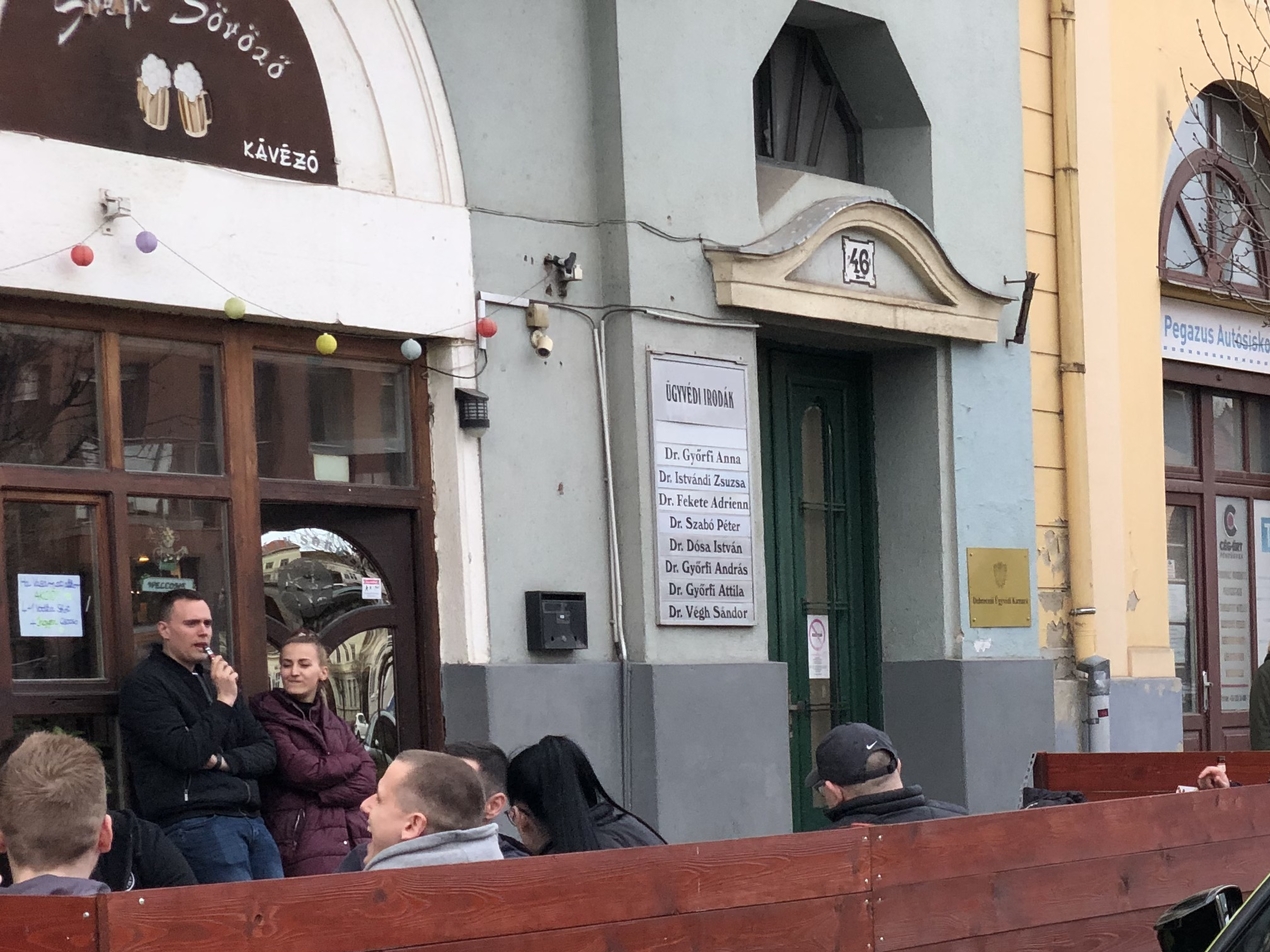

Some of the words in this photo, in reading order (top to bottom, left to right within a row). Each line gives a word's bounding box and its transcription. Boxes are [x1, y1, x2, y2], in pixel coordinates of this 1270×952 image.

[243, 137, 319, 174] KÁVÉZÓ
[849, 247, 870, 276] 46
[1164, 314, 1215, 346] Pegazus
[665, 380, 702, 405] ÜGYVÉDI
[703, 386, 735, 409] IRODÁK
[664, 446, 681, 460] Dr.
[682, 448, 714, 465] Győrfi
[716, 451, 742, 465] Anna
[658, 469, 673, 483] Dr.
[674, 471, 711, 487] Istvándi
[713, 474, 747, 489] Zsuzsa
[658, 493, 675, 506] Dr.
[676, 494, 709, 508] Fekete
[710, 497, 749, 510] Adrienn
[669, 516, 683, 529] Dr.
[685, 516, 715, 531] Szabó
[717, 518, 741, 532] Péter
[669, 538, 684, 552] Dr.
[686, 539, 711, 553] Dósa
[713, 540, 743, 554] István
[665, 560, 679, 573] Dr.
[681, 560, 712, 576] Győrfi
[714, 562, 749, 576] András
[668, 582, 683, 596] Dr.
[685, 582, 716, 598] Győrfi
[718, 584, 745, 598] Attila
[668, 605, 683, 618] Dr.
[686, 605, 711, 621] Végh
[713, 605, 748, 619] Sándor
